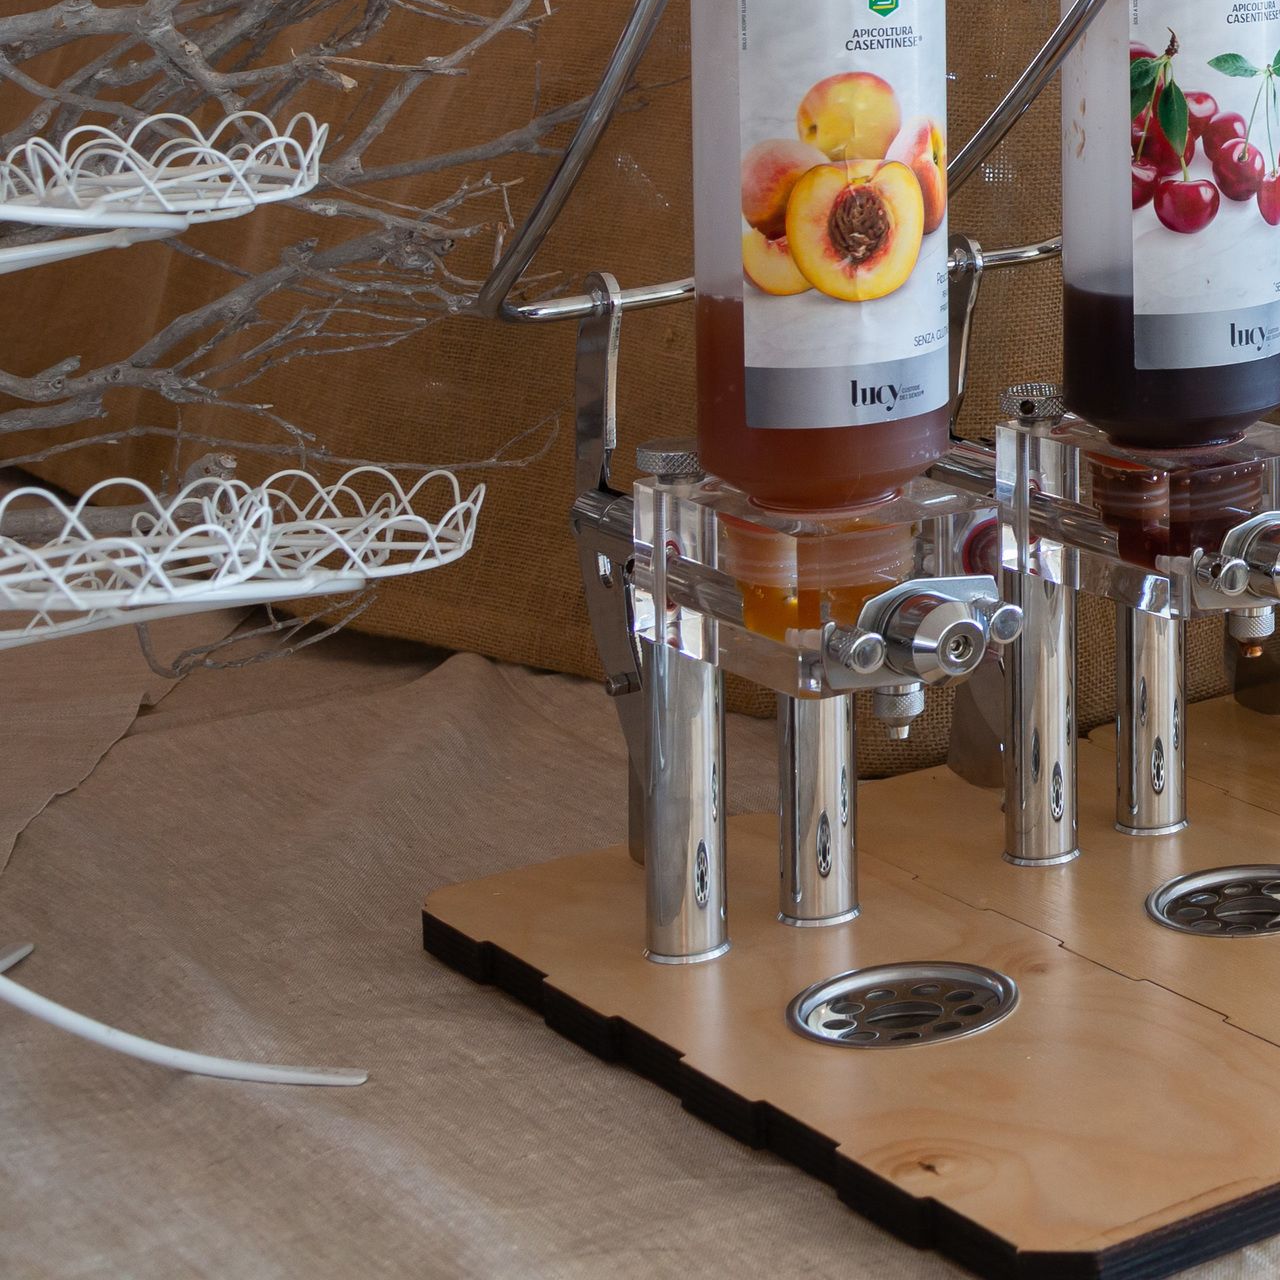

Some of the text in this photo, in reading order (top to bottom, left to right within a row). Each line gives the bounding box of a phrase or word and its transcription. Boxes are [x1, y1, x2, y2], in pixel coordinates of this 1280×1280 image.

[1231, 0, 1276, 13] APICOLTURA
[852, 25, 914, 39] APICOLTURA
[913, 332, 935, 347] SENZA
[1230, 322, 1267, 352] lucy
[850, 380, 901, 412] lucy
